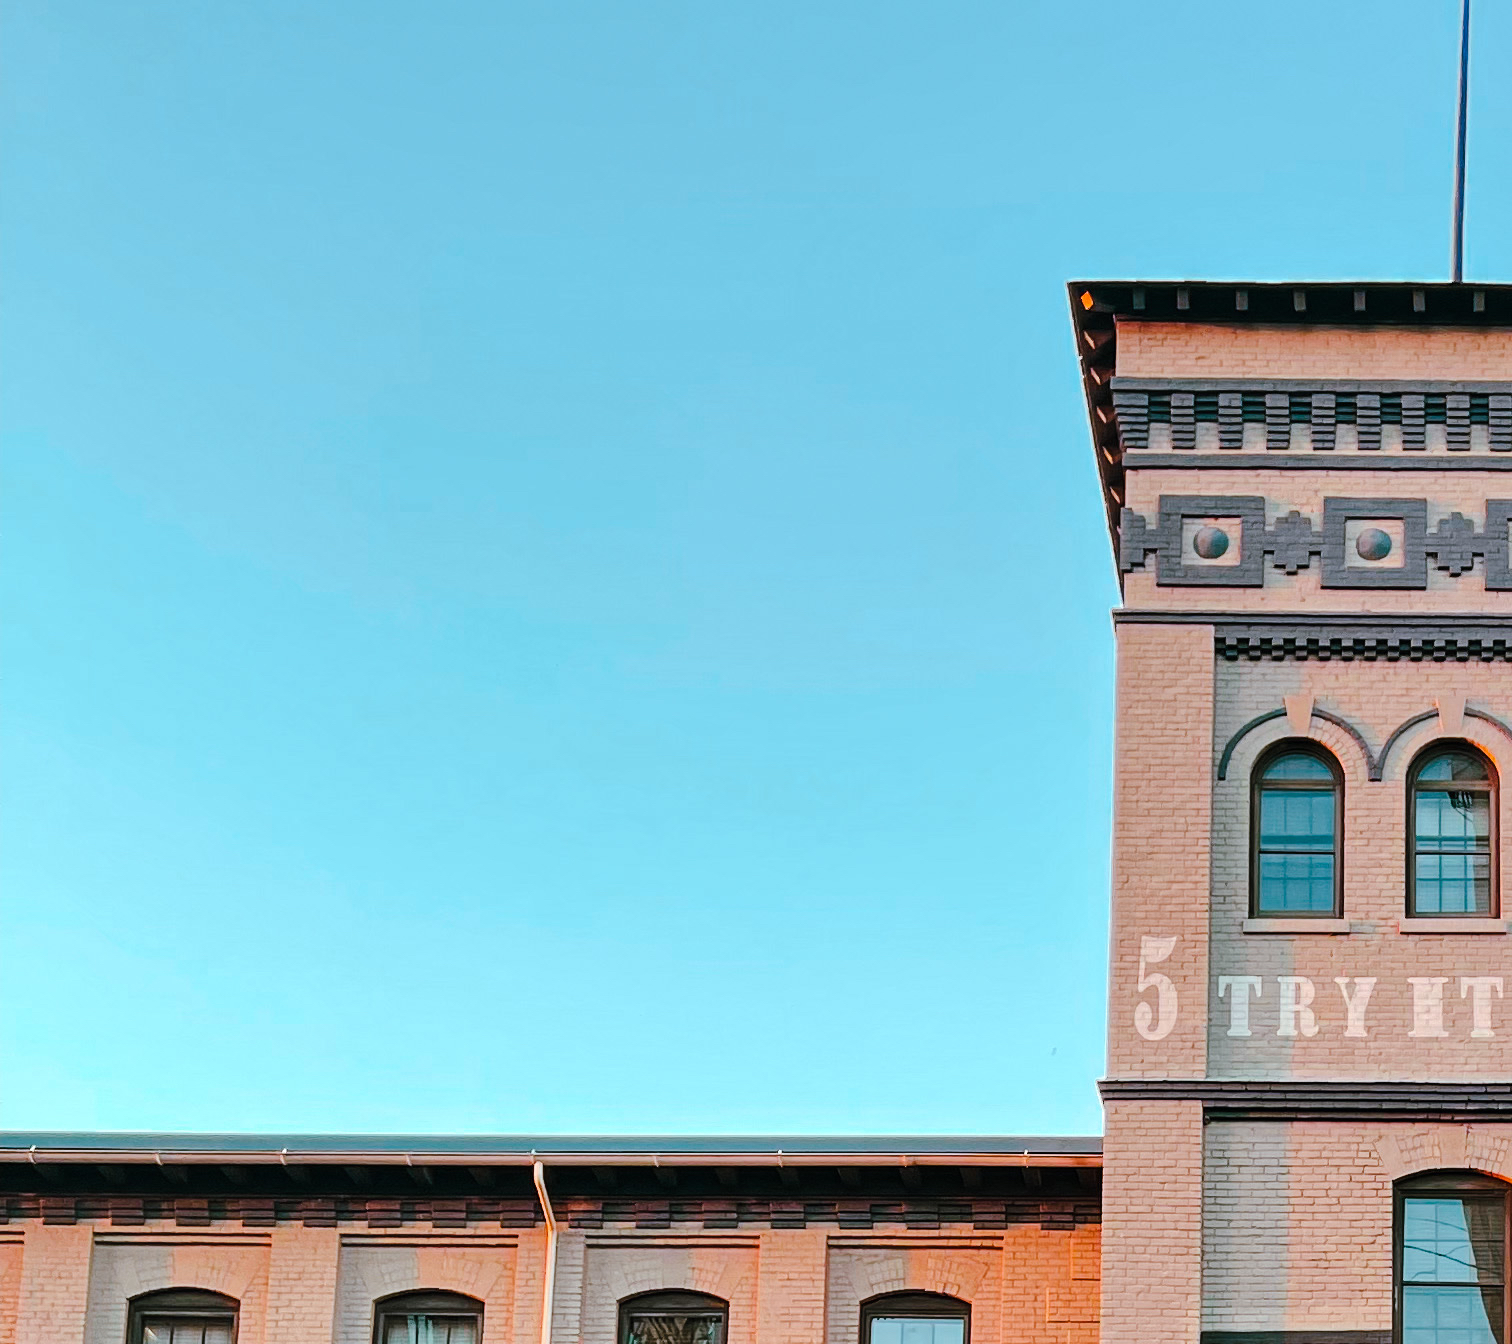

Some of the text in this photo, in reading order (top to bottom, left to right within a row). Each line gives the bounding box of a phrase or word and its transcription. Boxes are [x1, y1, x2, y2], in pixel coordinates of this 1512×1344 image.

[1134, 935, 1178, 1041] 5
[1217, 975, 1378, 1037] TRY
[1407, 976, 1504, 1038] IT
